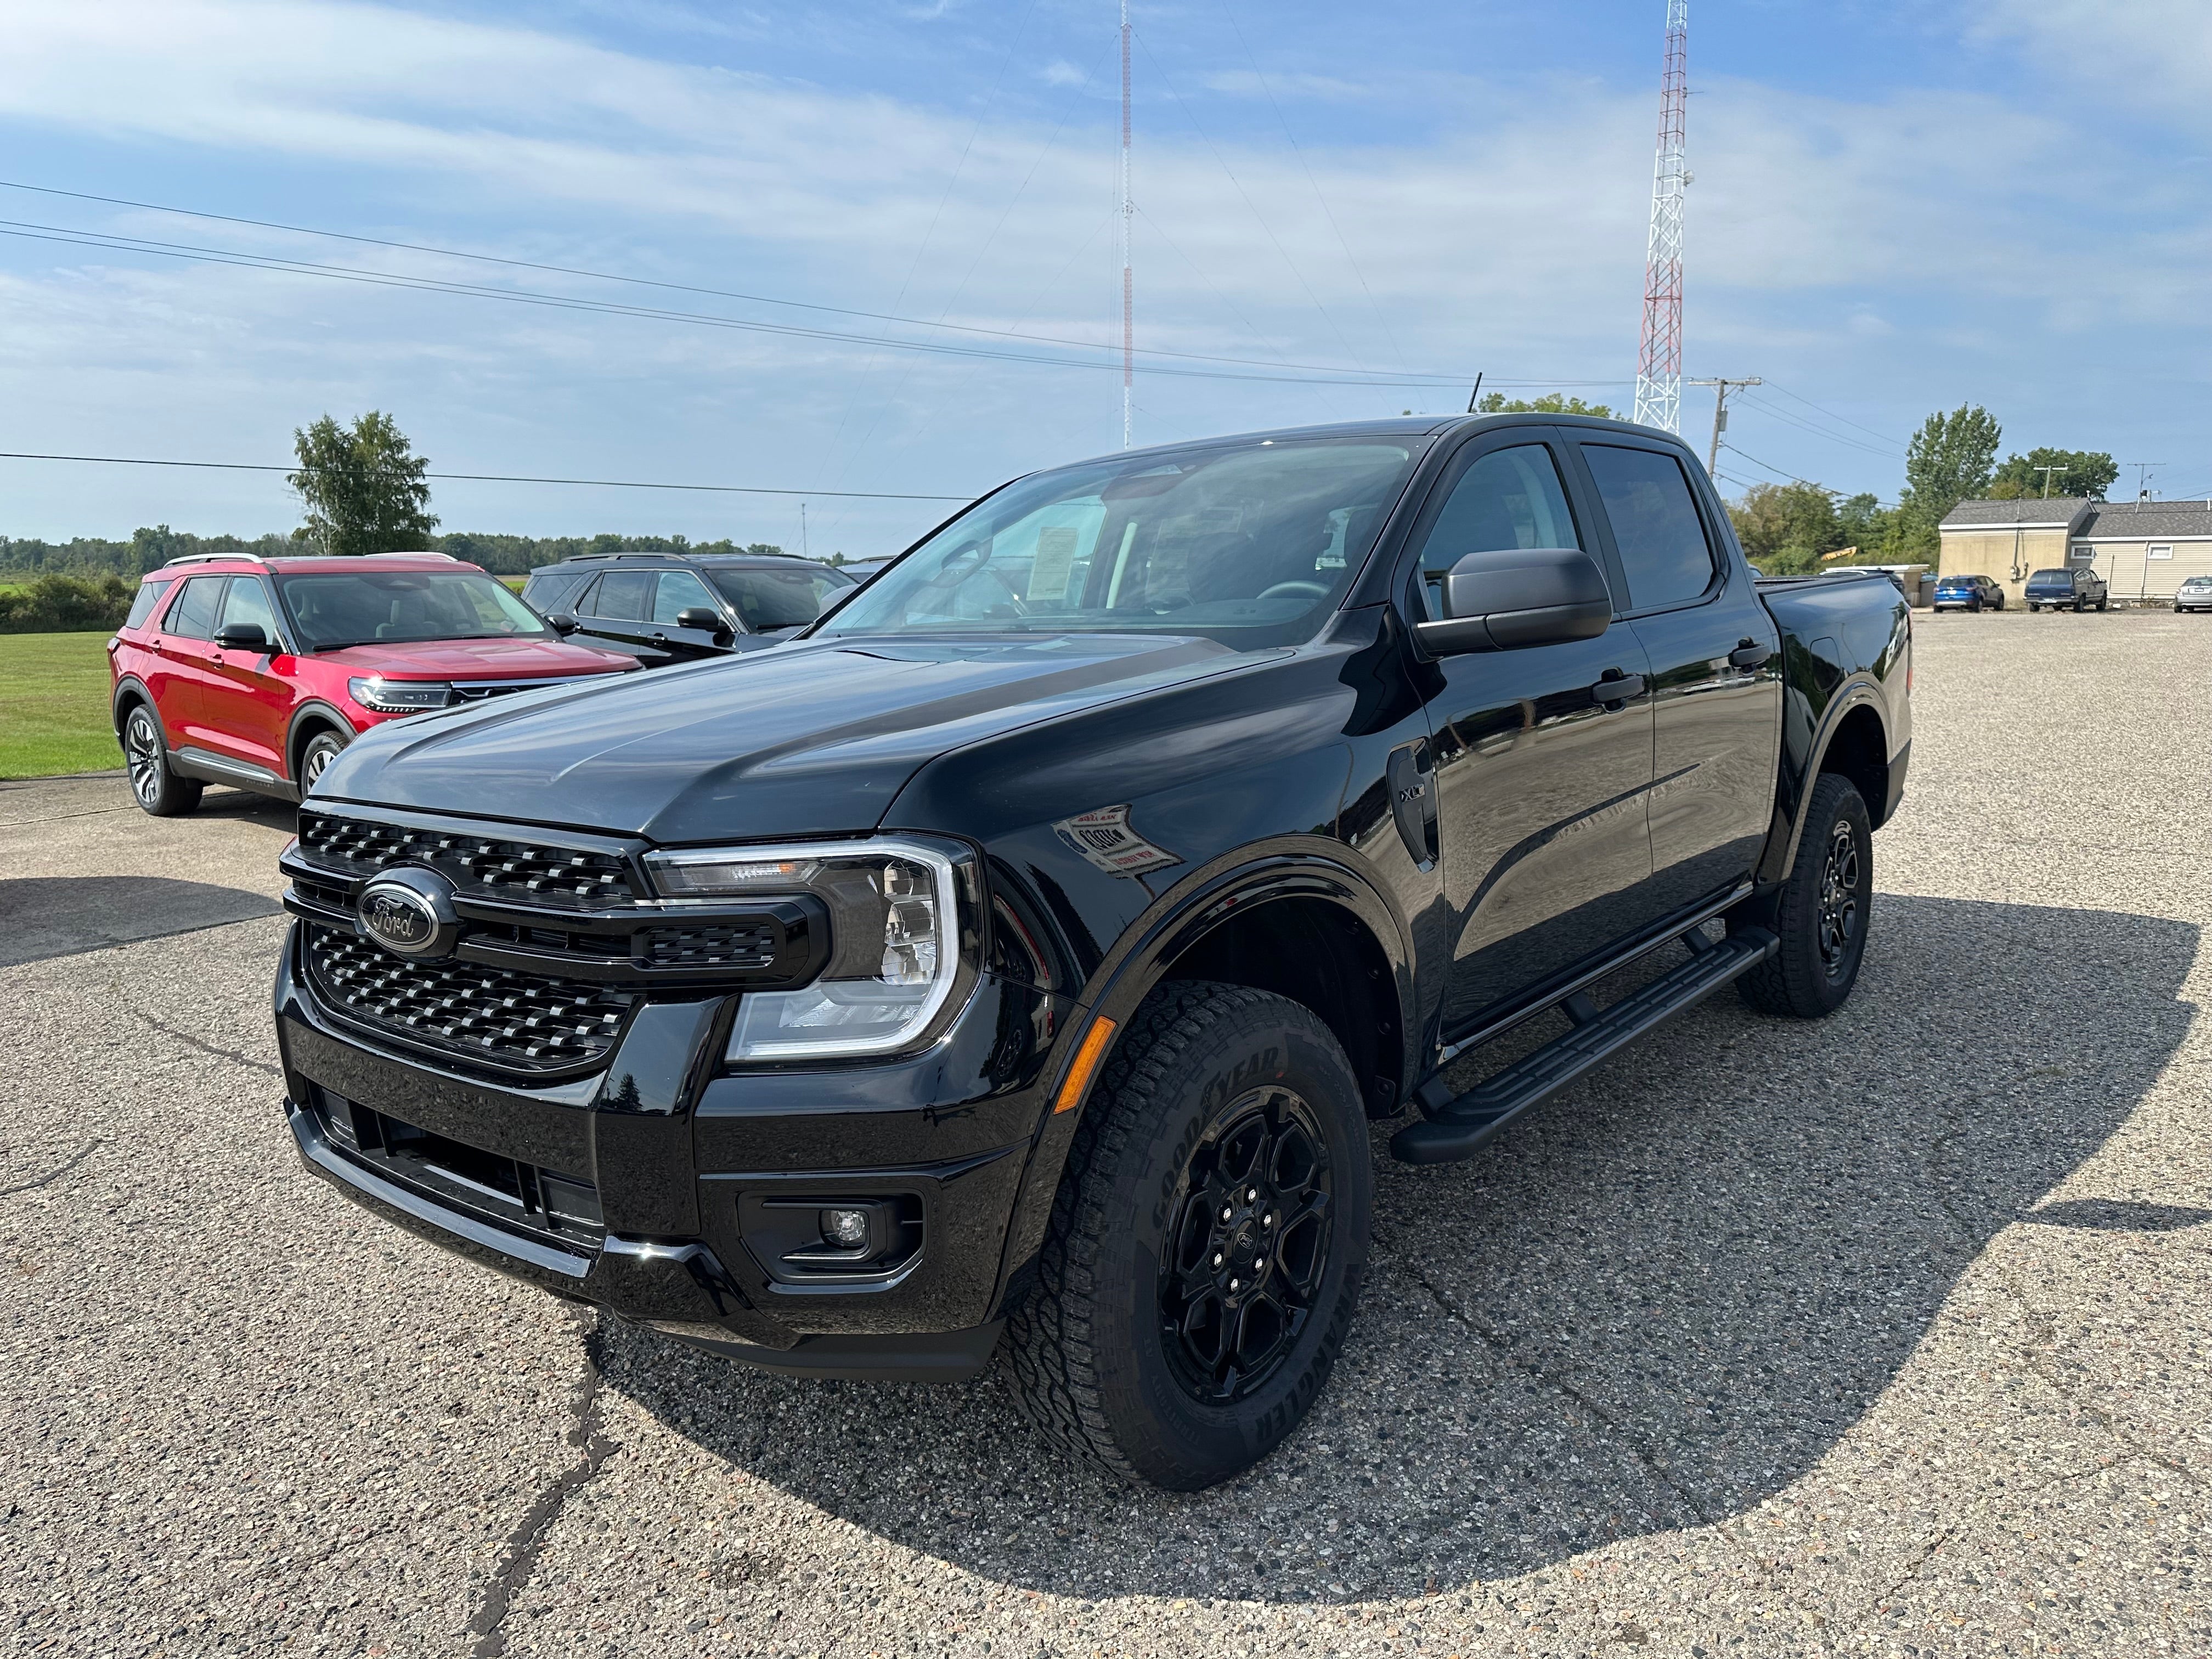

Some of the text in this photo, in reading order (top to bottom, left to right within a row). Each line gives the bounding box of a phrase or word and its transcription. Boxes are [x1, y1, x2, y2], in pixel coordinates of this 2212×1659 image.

[1400, 783, 1425, 803] XLT
[372, 897, 414, 937] Ford
[1153, 1047, 1278, 1228] GOODYEAR
[1255, 1264, 1360, 1442] WRANGLER
